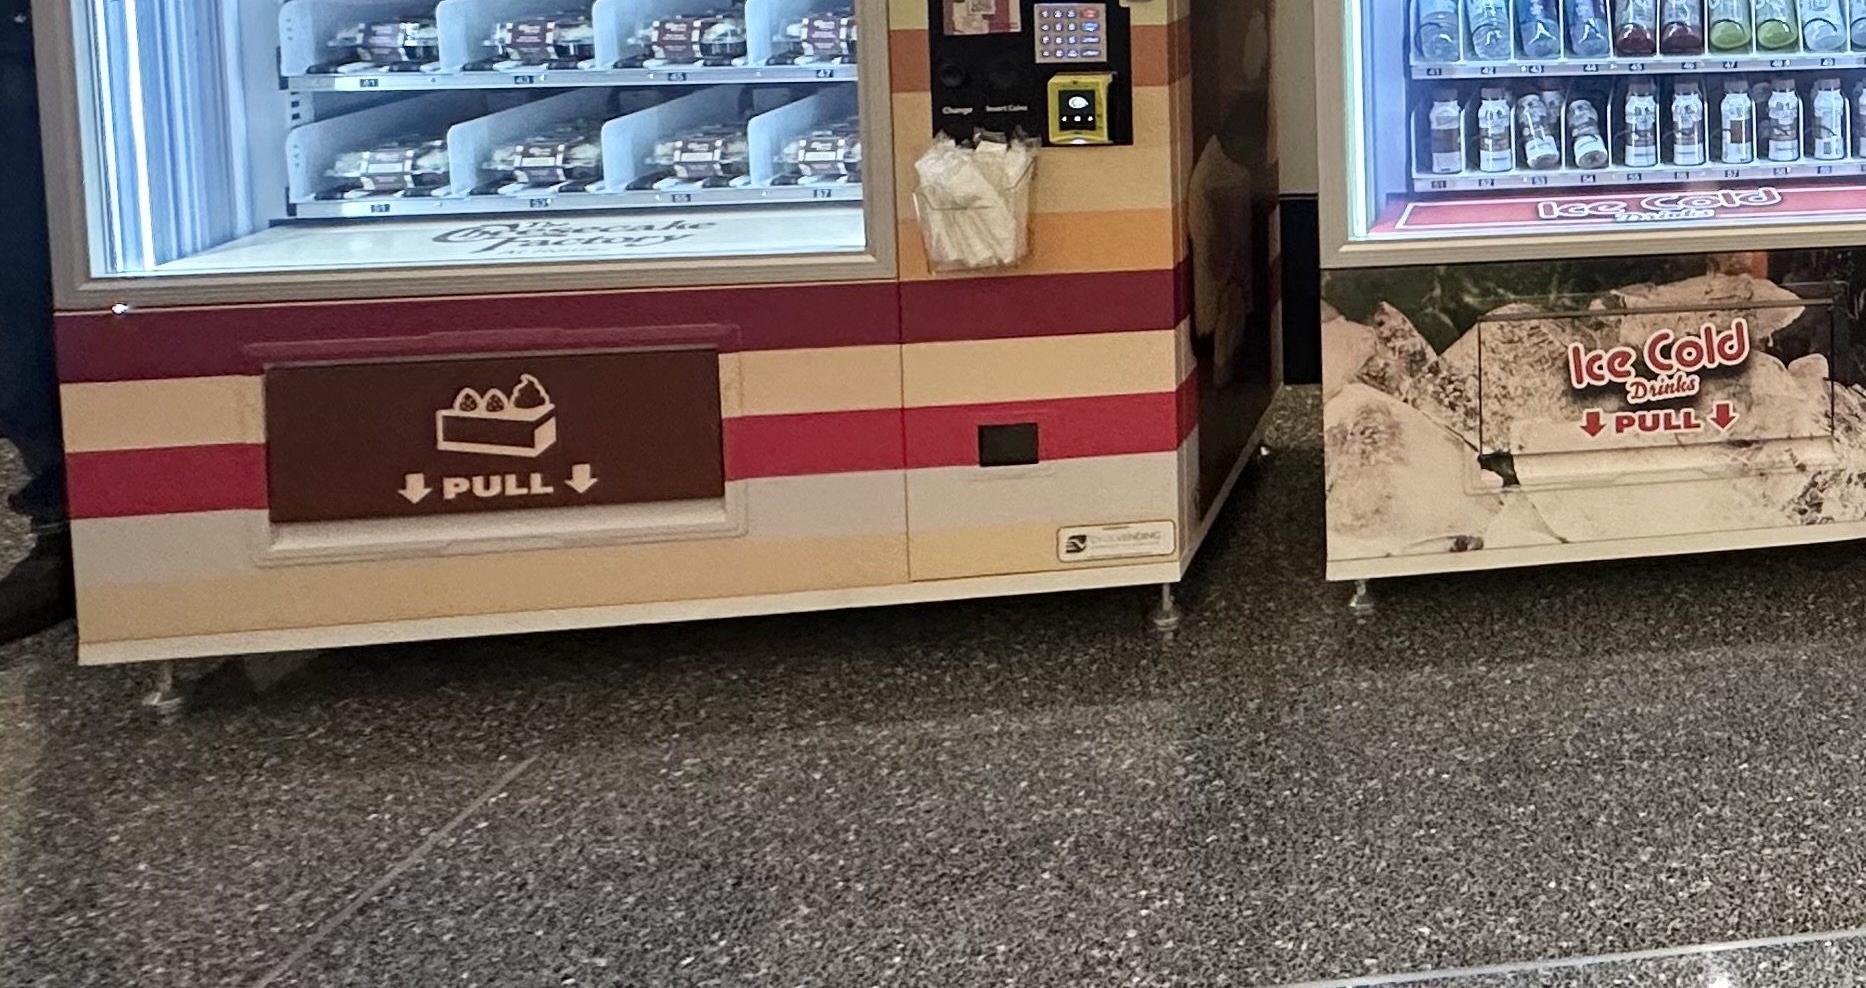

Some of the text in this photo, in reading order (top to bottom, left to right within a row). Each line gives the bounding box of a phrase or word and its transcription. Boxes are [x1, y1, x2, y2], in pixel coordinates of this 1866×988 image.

[942, 106, 973, 114] Change
[1537, 187, 1782, 219] Ice Cold
[432, 220, 717, 243] Cheesecake
[470, 233, 695, 254] Factory
[1569, 319, 1748, 388] Ice Cold
[1627, 373, 1699, 403] Drinks
[1615, 411, 1701, 433] PULL
[442, 472, 553, 499] PULL
